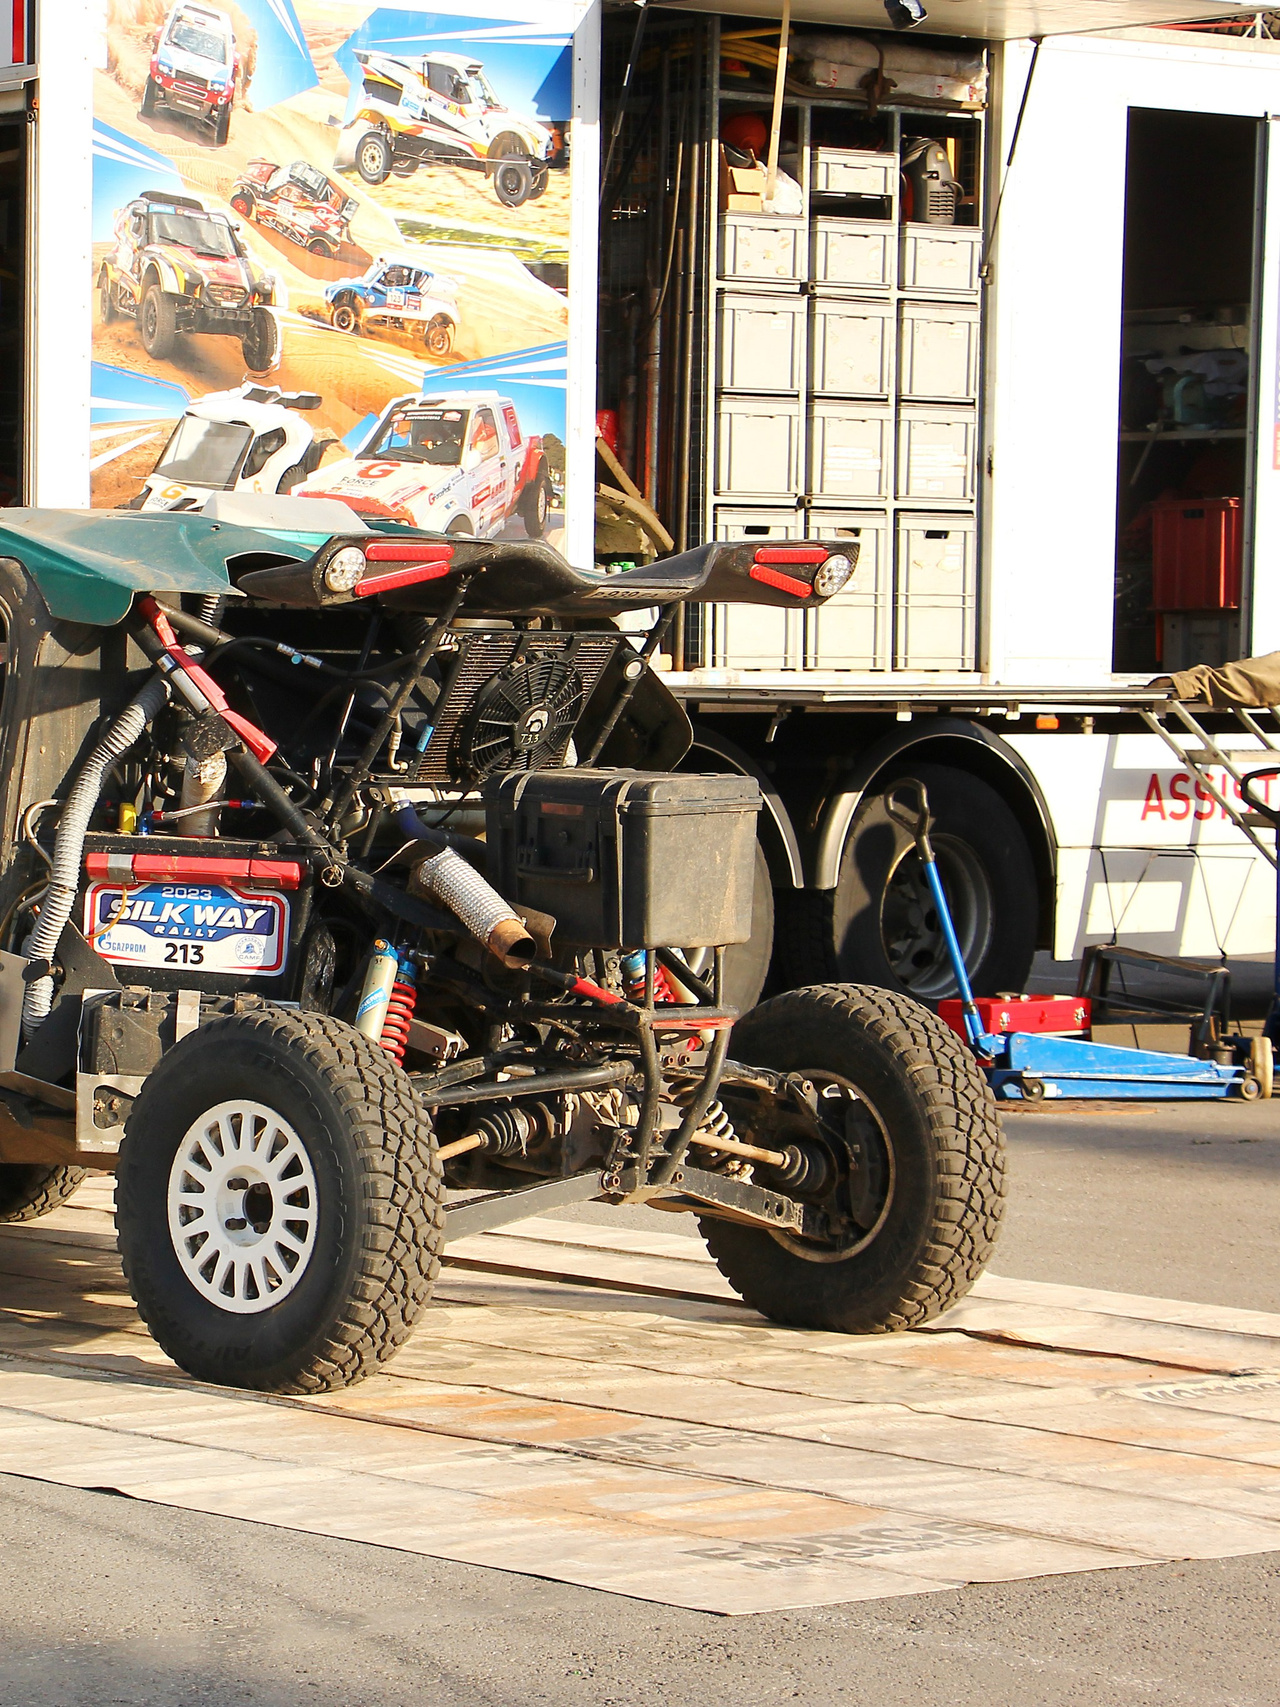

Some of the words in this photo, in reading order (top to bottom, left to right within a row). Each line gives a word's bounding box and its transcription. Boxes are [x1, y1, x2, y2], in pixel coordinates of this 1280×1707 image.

[356, 462, 402, 479] G
[340, 476, 381, 486] FORCE
[160, 484, 188, 500] G
[520, 733, 540, 744] T3.3
[161, 886, 213, 901] 2023
[107, 898, 190, 924] SILK
[194, 904, 268, 930] WAY
[153, 925, 218, 938] RALLY
[111, 943, 147, 954] GAZPROM
[164, 943, 204, 965] 213
[677, 1521, 993, 1562] FORCE
